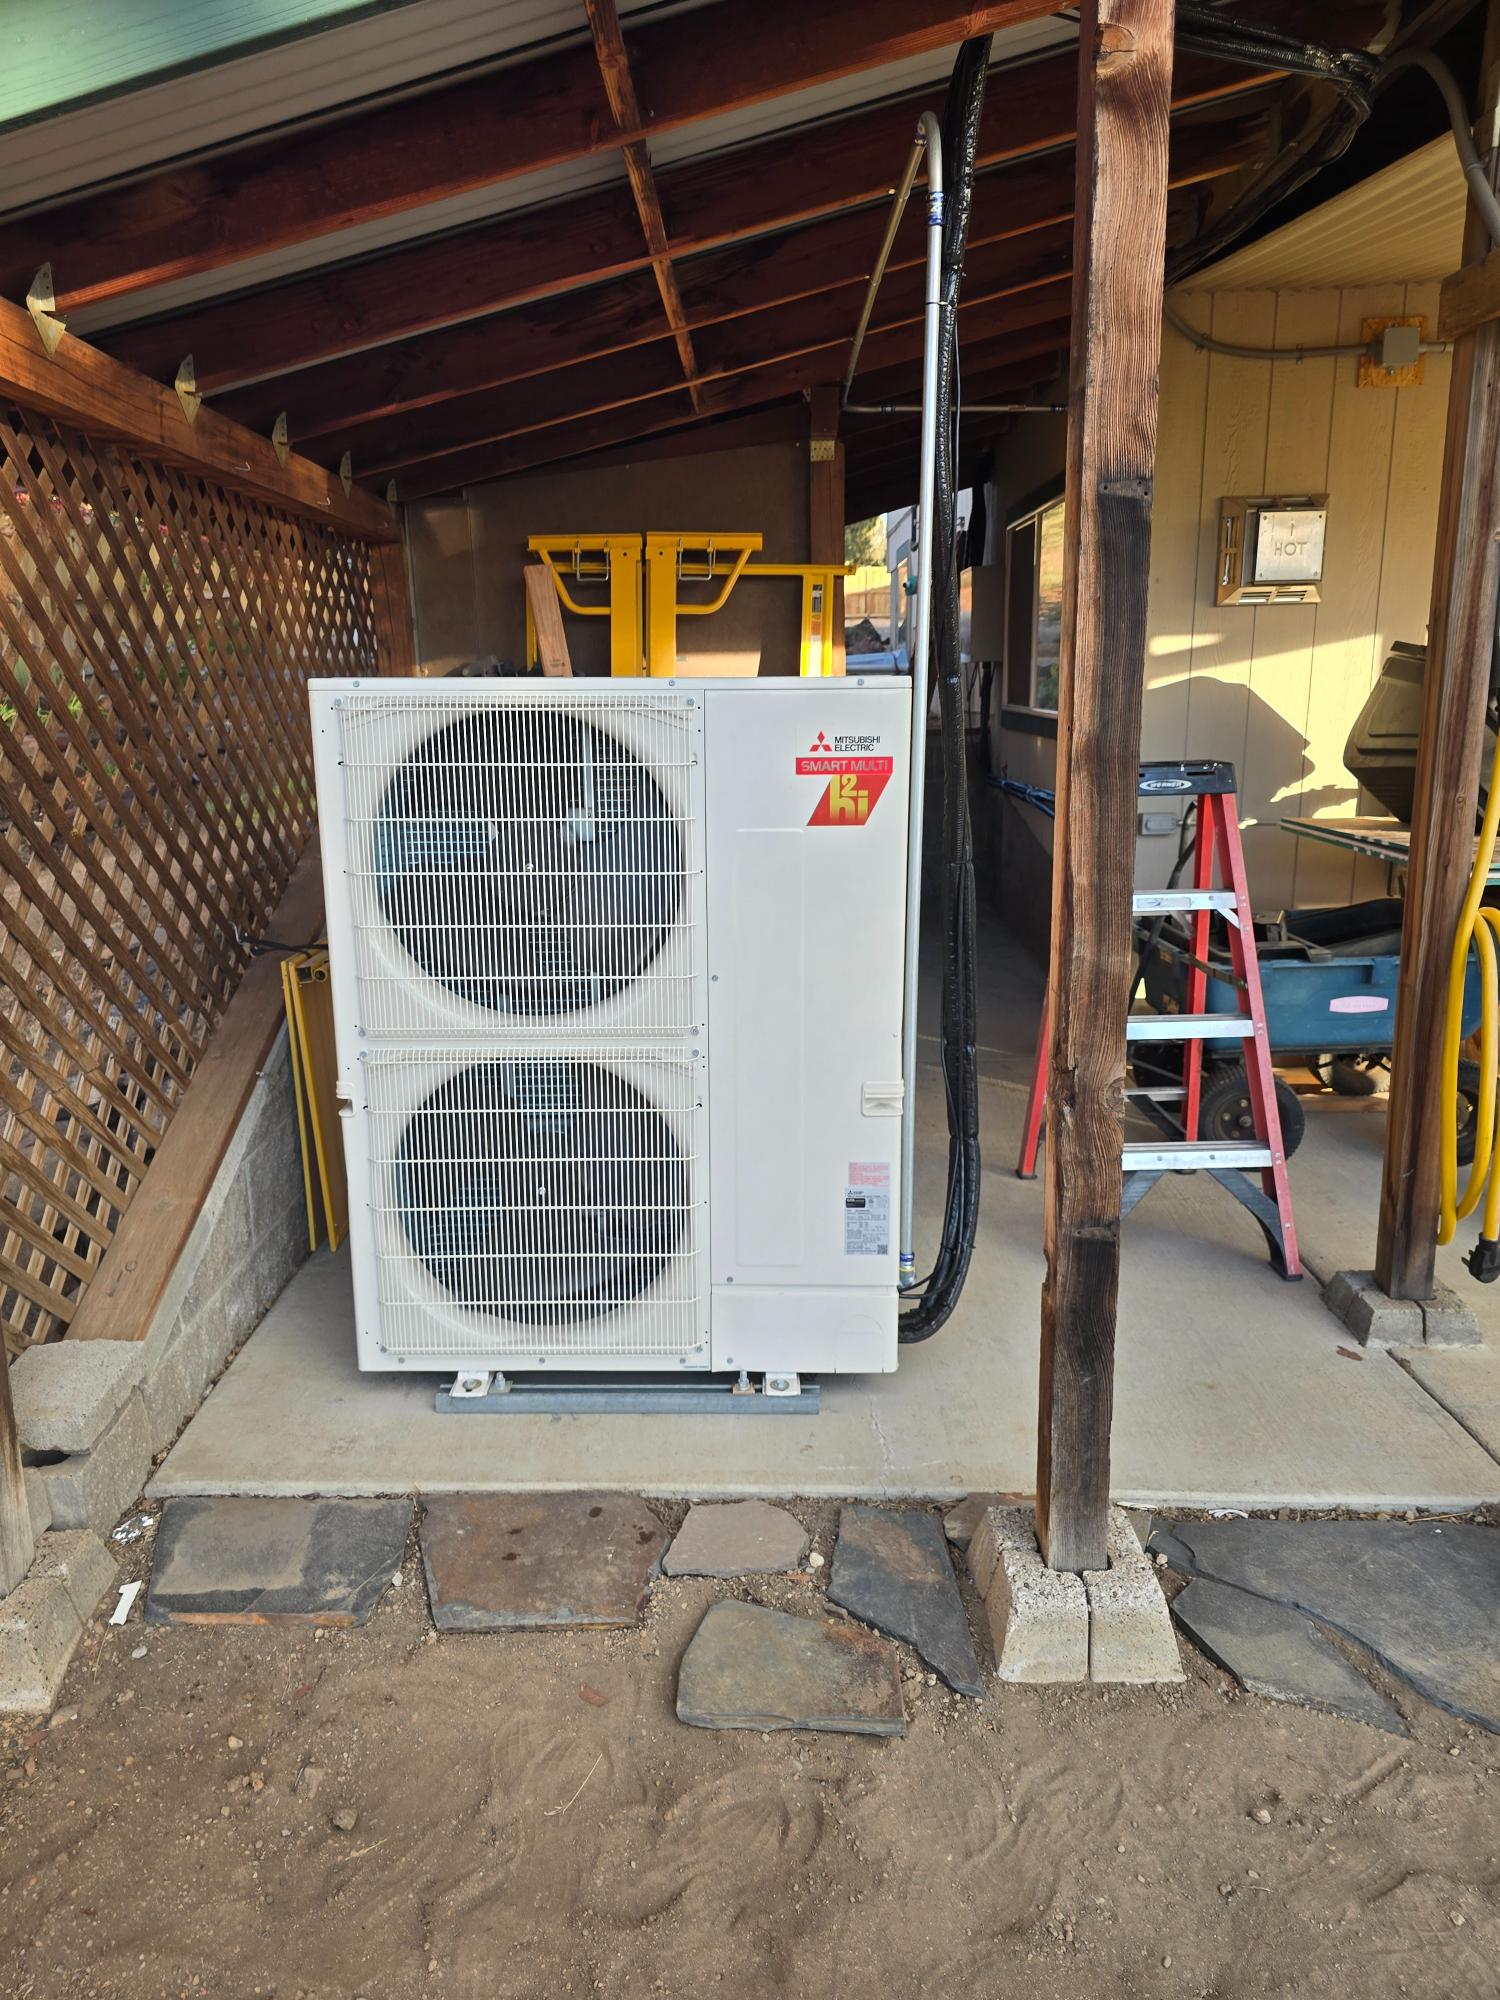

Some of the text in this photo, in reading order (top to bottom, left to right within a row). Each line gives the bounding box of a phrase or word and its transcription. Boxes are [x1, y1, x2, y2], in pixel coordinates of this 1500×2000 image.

[1274, 542, 1307, 556] HOT
[834, 736, 881, 744] MITSUBISHI
[834, 744, 875, 752] ELECTRIC
[801, 759, 889, 772] SMART MULTI
